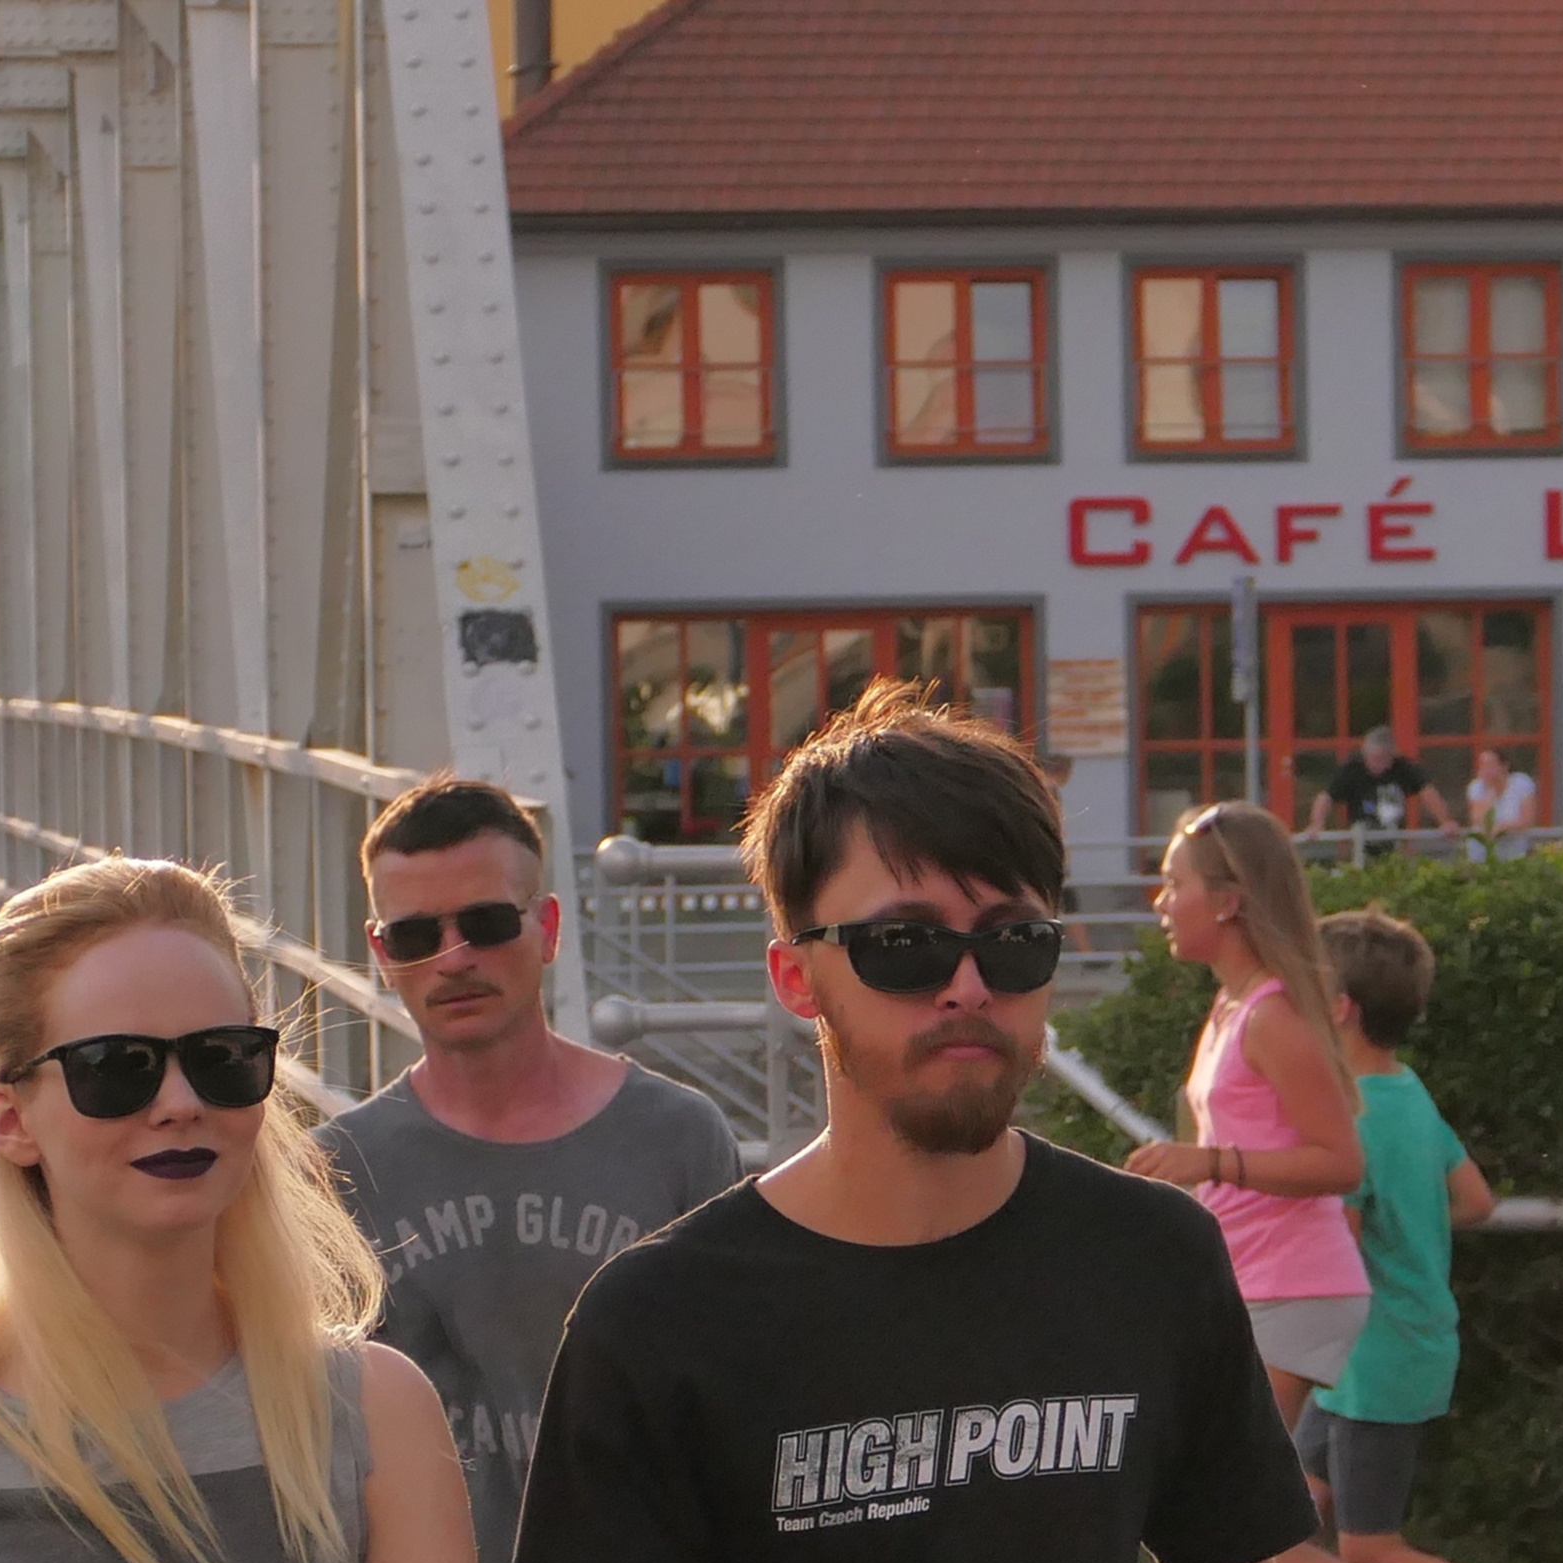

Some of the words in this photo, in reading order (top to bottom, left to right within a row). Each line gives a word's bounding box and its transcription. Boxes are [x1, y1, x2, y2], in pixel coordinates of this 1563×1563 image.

[1069, 475, 1436, 567] CAFÉ
[389, 1195, 495, 1284] AMP
[517, 1193, 648, 1260] GLOR
[772, 1410, 943, 1510] HIGH
[945, 1394, 1138, 1486] POINT
[776, 1516, 815, 1532] Team
[818, 1506, 863, 1528] Czech
[867, 1495, 930, 1520] Republic
